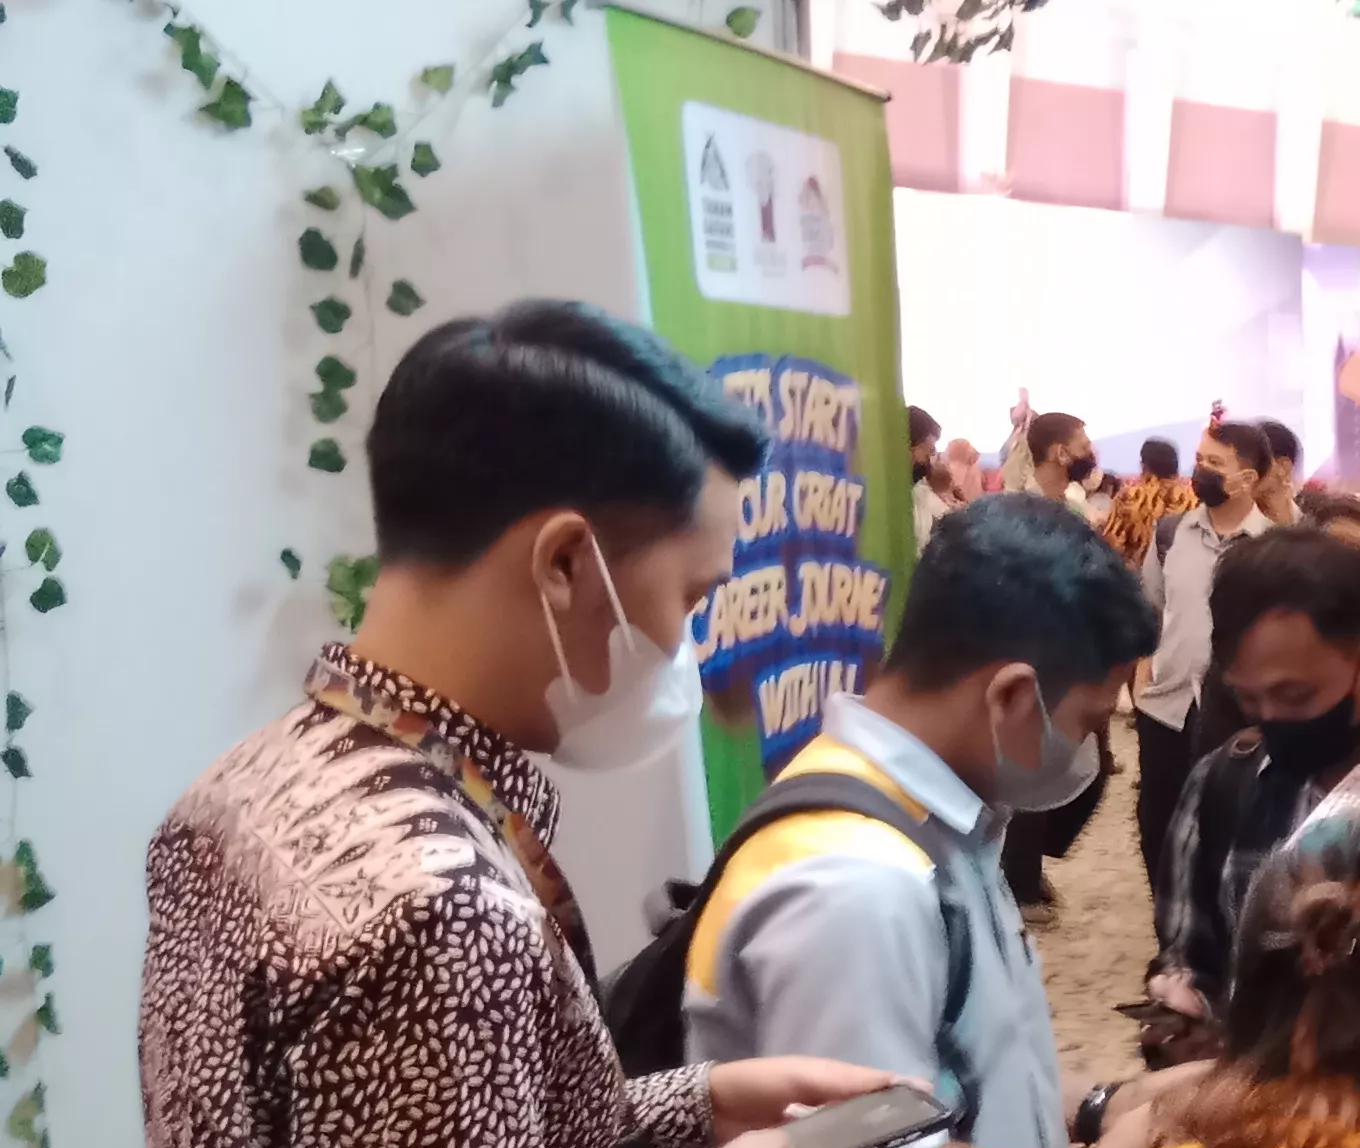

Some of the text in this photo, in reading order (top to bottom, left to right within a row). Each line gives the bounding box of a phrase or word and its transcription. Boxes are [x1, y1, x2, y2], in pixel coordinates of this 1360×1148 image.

[778, 368, 863, 451] START
[738, 471, 788, 542] OUR
[688, 566, 788, 663] CAREER
